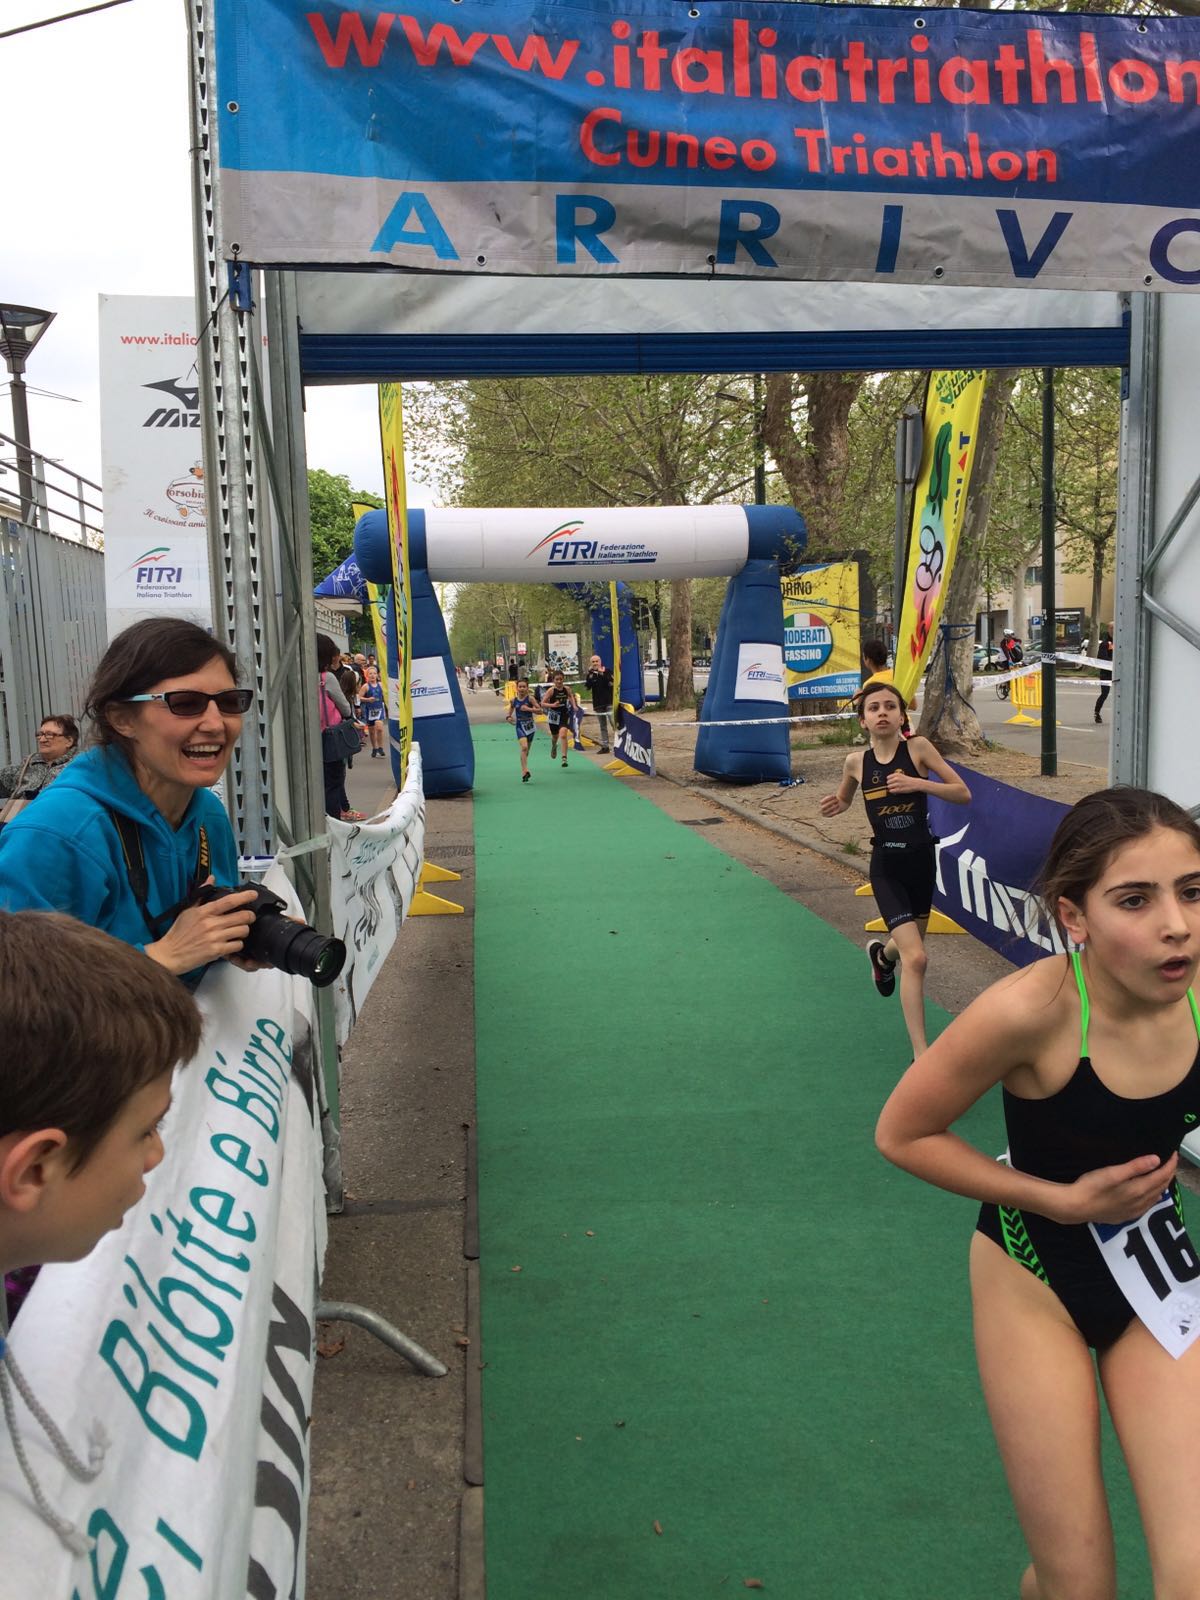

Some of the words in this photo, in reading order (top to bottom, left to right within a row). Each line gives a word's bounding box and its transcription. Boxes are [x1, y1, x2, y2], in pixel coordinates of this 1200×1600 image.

[579, 108, 777, 171] Cuneo
[794, 128, 1058, 182] Triathlon
[120, 332, 198, 346] www.italia
[142, 408, 201, 427] MIZ
[153, 514, 187, 528] croissant
[549, 541, 598, 559] FITRI
[598, 551, 625, 559] Italiana
[627, 550, 657, 558] Triathlon
[600, 543, 645, 551] Federazione
[136, 567, 182, 583] FITRI
[781, 581, 812, 596] ORINO
[785, 648, 822, 661] FASSINO
[799, 687, 809, 695] NEL
[204, 1018, 293, 1143] Birre
[210, 1132, 269, 1187] e
[99, 1186, 257, 1461] Bibite
